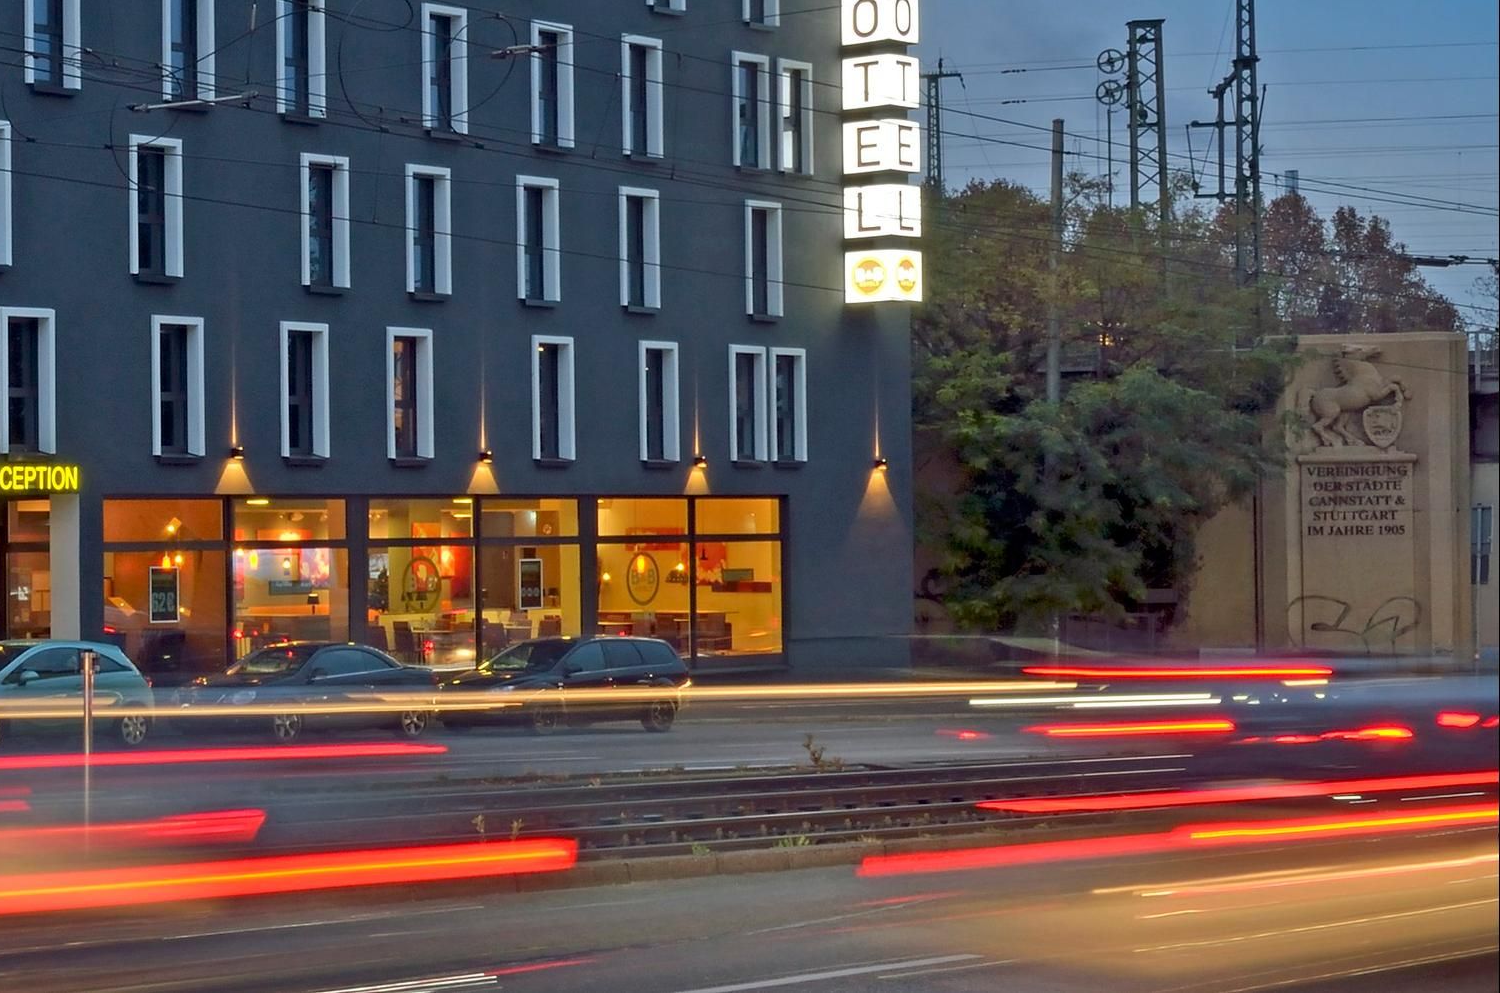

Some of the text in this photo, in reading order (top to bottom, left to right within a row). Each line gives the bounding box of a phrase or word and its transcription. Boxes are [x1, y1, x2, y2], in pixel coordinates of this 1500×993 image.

[1307, 465, 1408, 477] VEREINIGUNG
[1313, 481, 1341, 492] DER
[1308, 495, 1406, 506] CANNSTATT &
[1312, 510, 1398, 521] STUTTGART
[1307, 525, 1406, 536] IM JAHRE 1905
